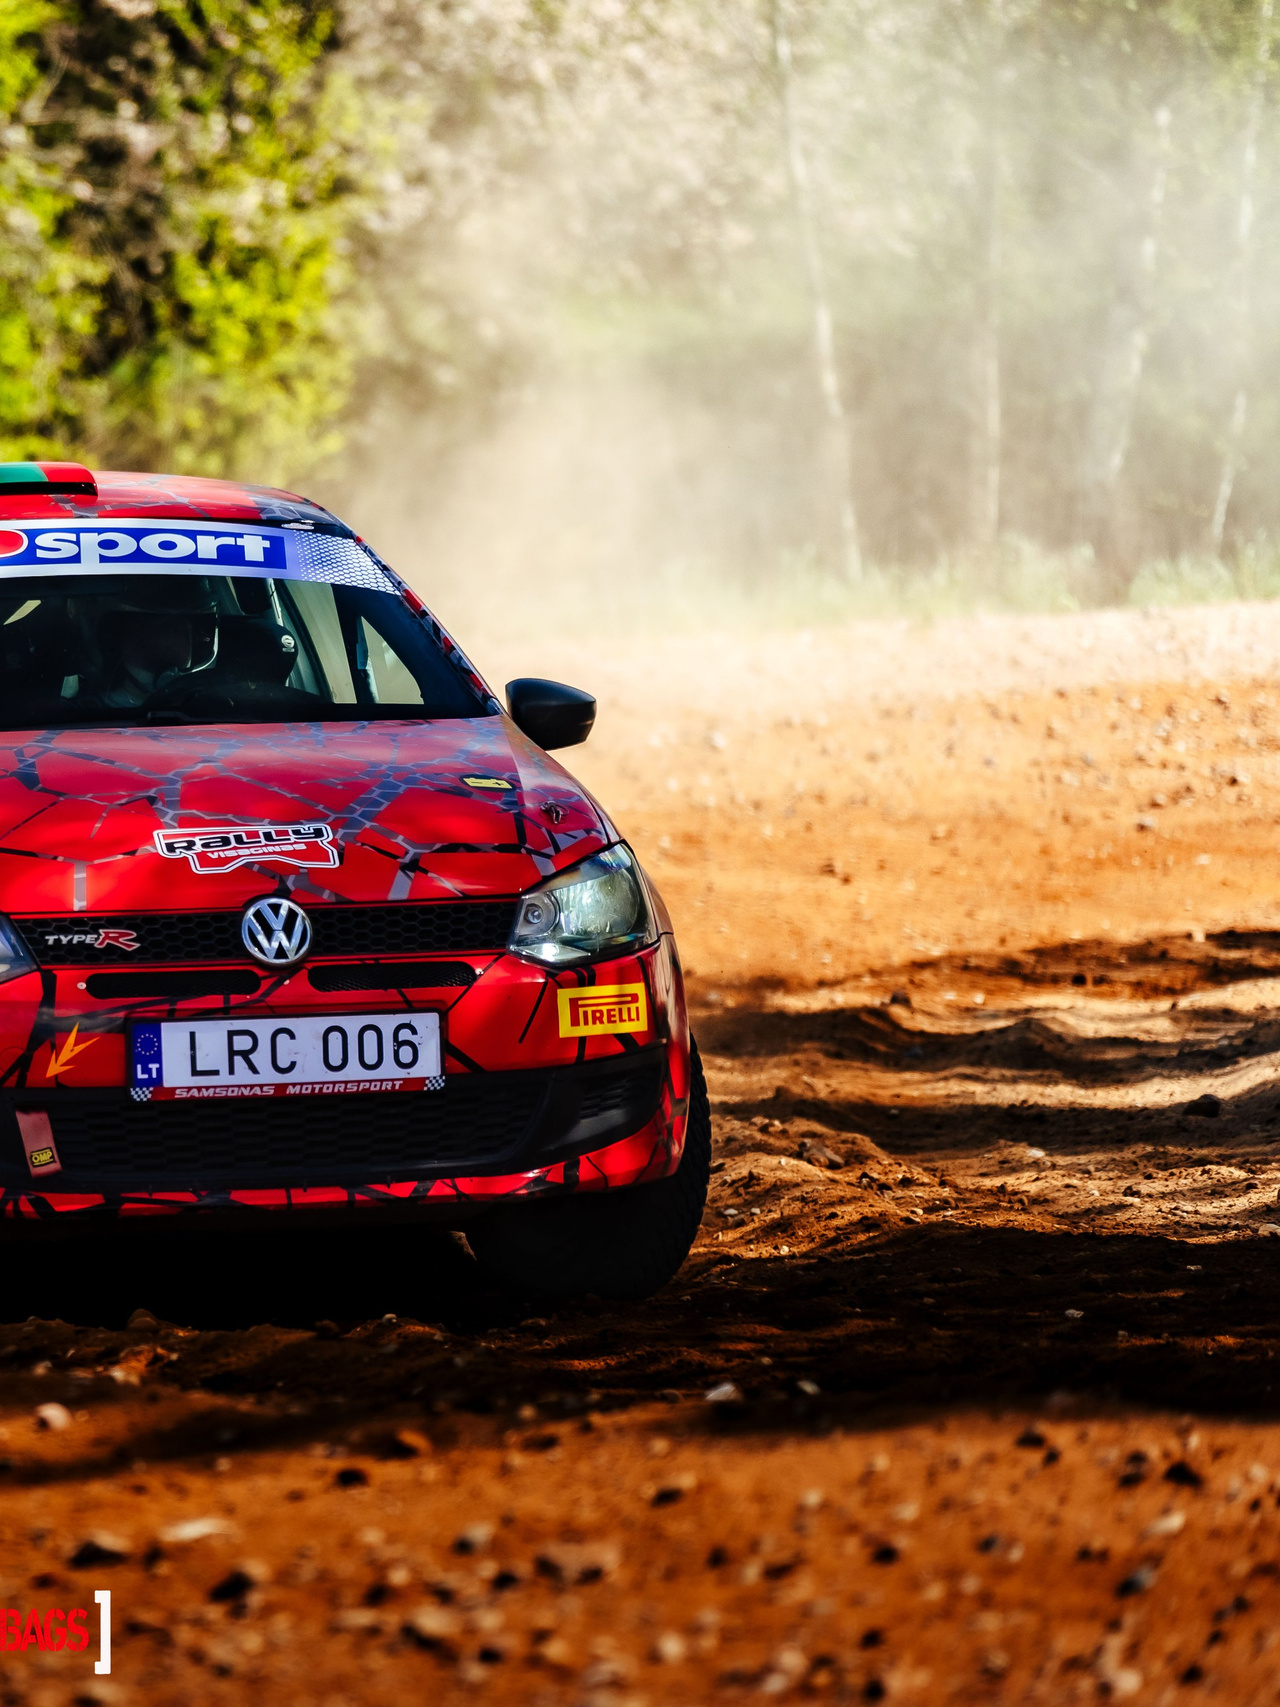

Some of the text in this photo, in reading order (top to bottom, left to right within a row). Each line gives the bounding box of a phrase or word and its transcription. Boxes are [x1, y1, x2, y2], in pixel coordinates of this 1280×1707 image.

[568, 993, 640, 1028] PIRELLI
[189, 1022, 419, 1077] LRC 006
[136, 1063, 160, 1079] LT
[174, 1080, 404, 1099] SAMSONAS MOTORSPORT
[31, 1151, 53, 1163] OMP
